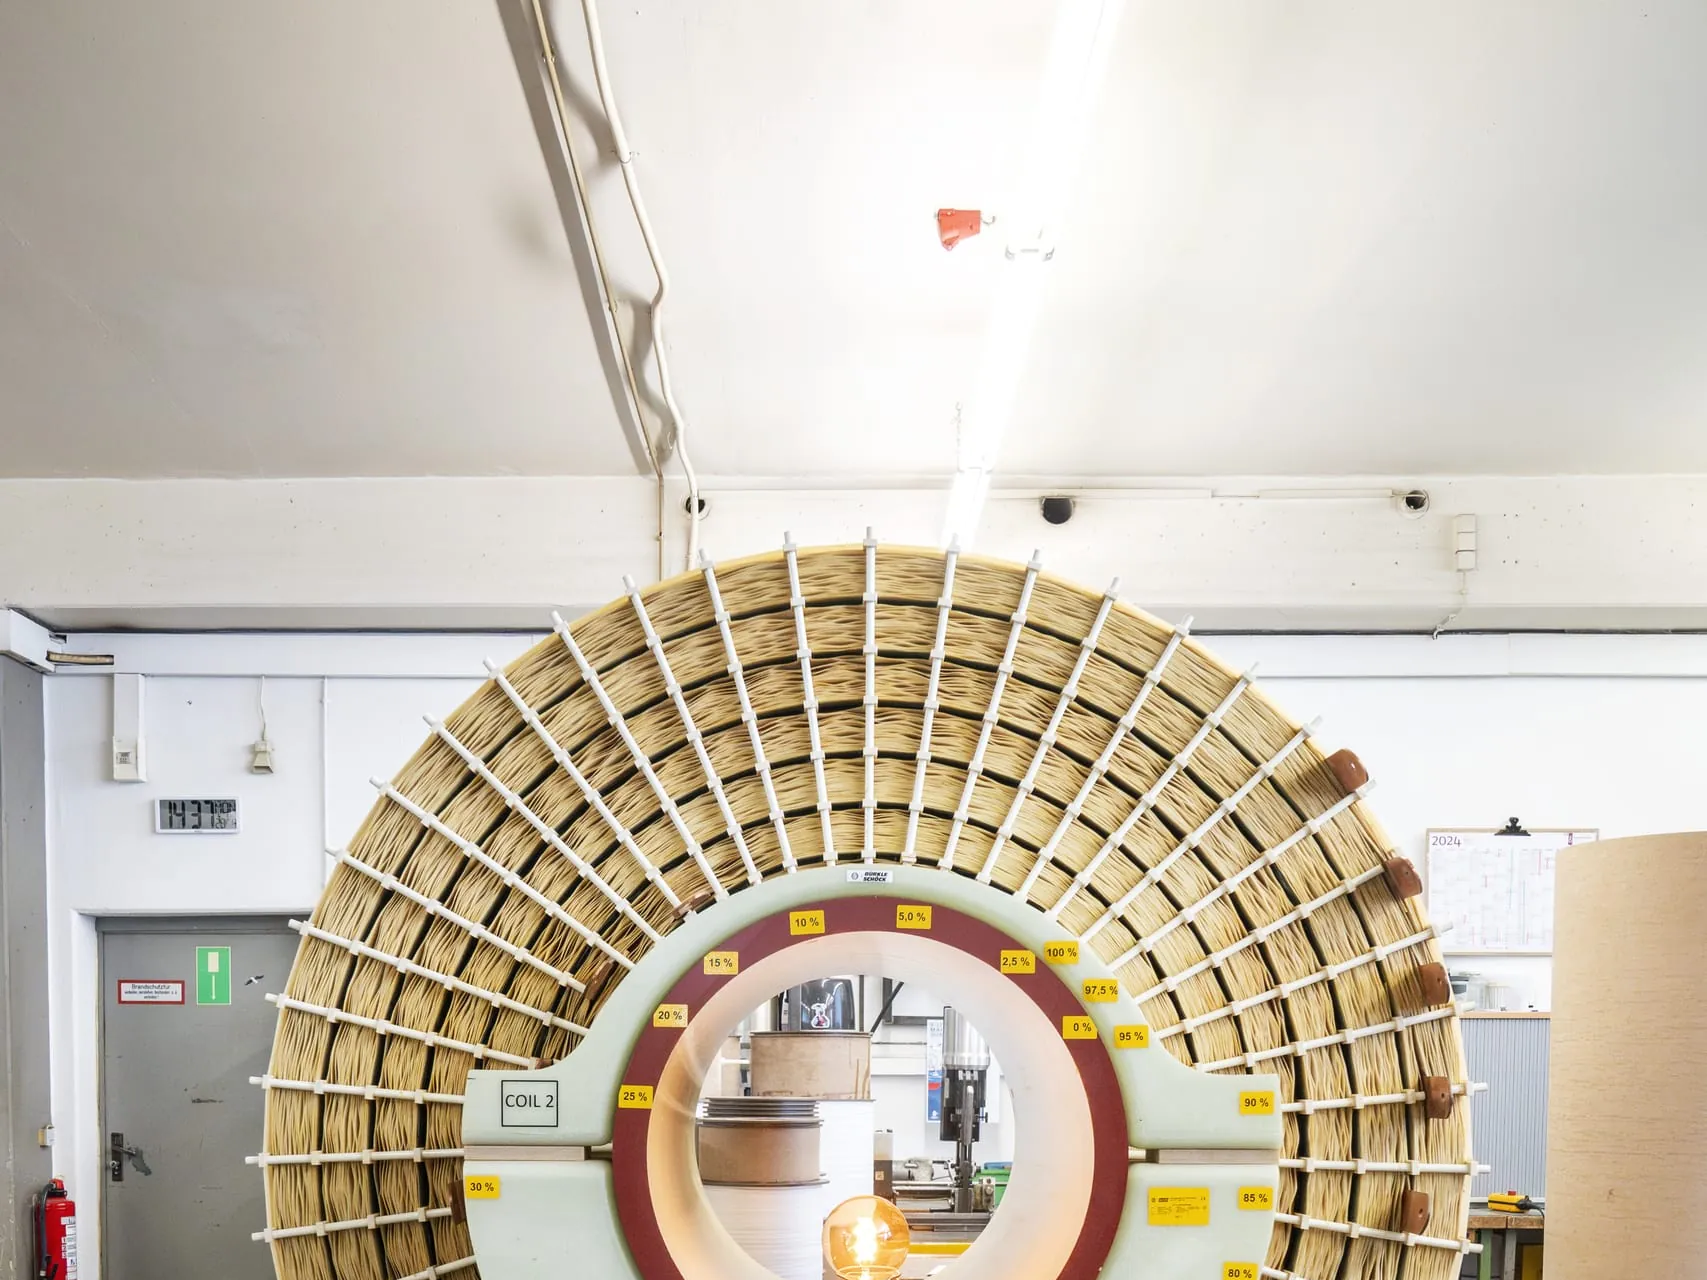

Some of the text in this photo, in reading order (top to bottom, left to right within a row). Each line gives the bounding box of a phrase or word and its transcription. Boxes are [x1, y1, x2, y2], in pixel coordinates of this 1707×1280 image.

[1431, 835, 1461, 847] 2024
[898, 912, 926, 922] 5,0 %
[796, 918, 819, 927] 10 %
[1047, 948, 1076, 957] 100 %
[709, 958, 732, 967] 15 %
[1002, 957, 1030, 967] 2,5 %
[1085, 985, 1118, 995] 97,5 %
[658, 1011, 682, 1020] 20 %
[1074, 1022, 1091, 1032] 0 %
[1119, 1032, 1144, 1040] 95 %
[505, 1094, 554, 1108] COIL 2
[624, 1092, 647, 1101] 25 %
[1244, 1098, 1269, 1107] 90 %
[470, 1182, 494, 1191] 30 %
[1244, 1193, 1268, 1202] 85 %
[1228, 1268, 1252, 1278] 80 %
